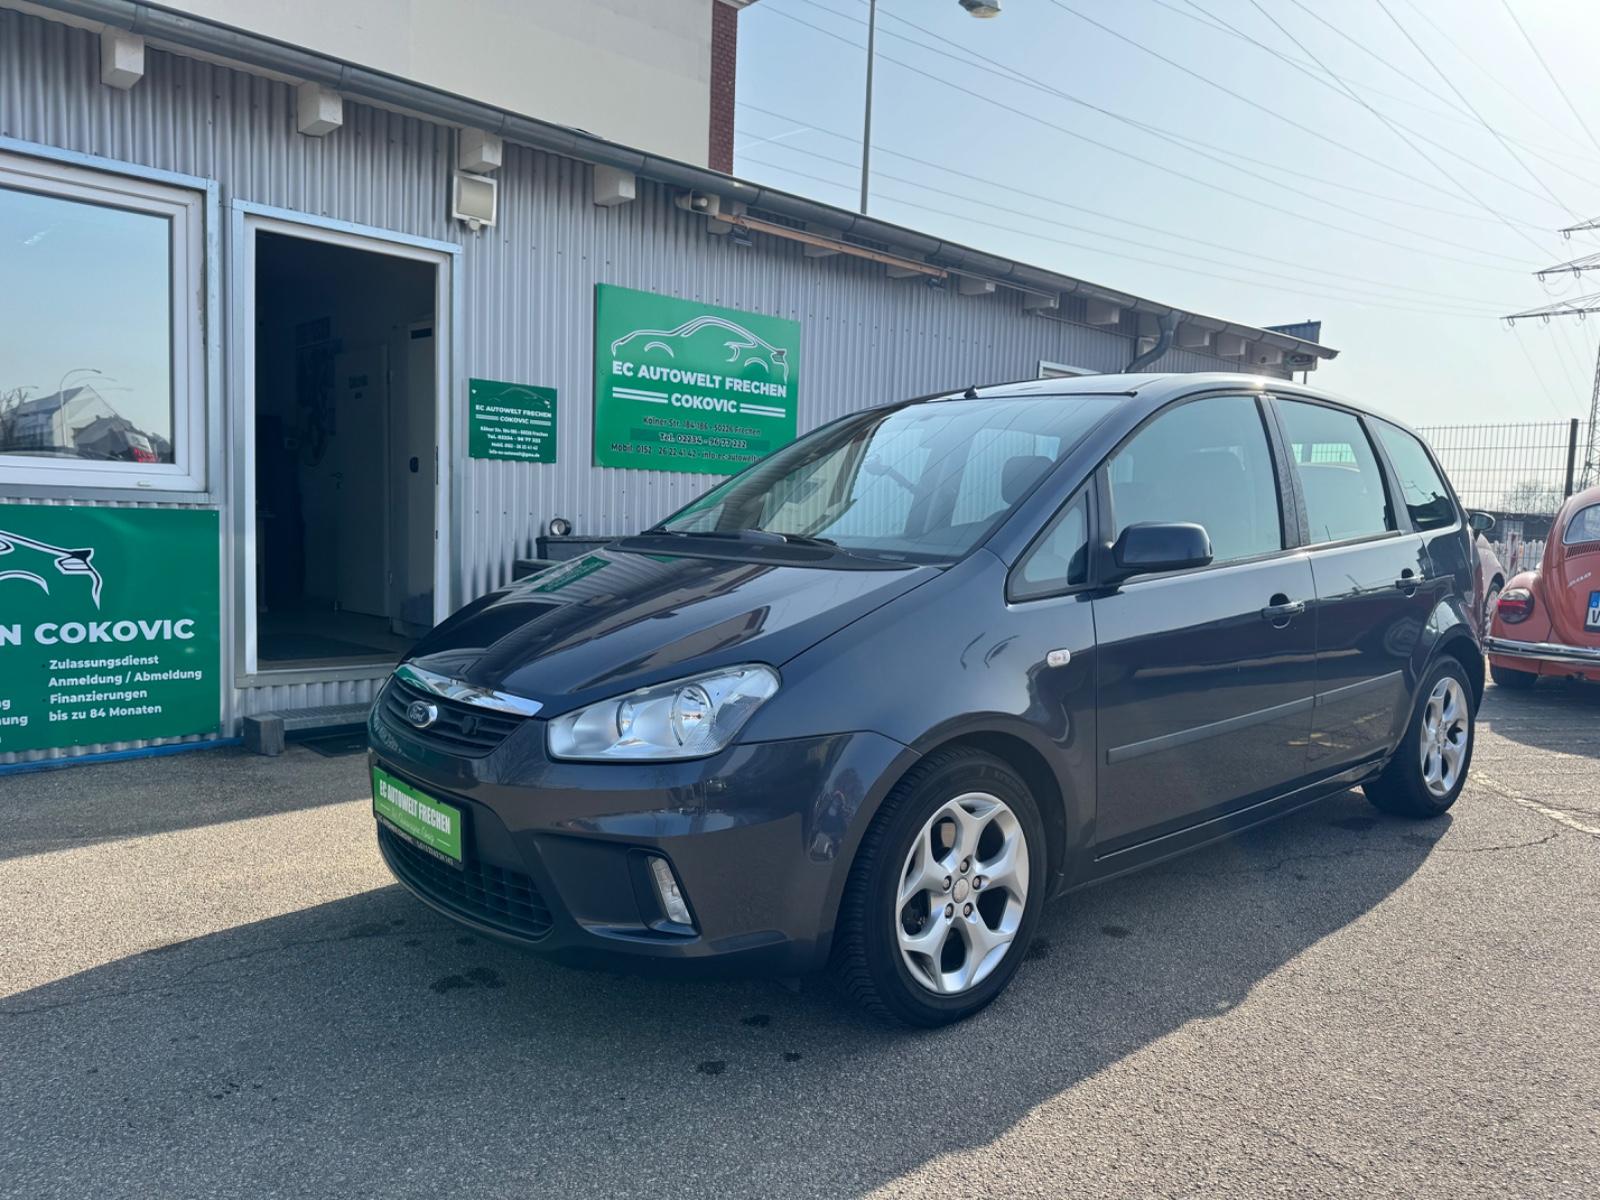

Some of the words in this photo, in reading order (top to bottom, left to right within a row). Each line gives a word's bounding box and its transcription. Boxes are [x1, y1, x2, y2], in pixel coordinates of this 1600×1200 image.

[612, 360, 634, 377] EC
[637, 365, 722, 389] AUTOWELT
[725, 377, 788, 398] FRECHEN
[486, 406, 521, 415] AUTOWELT
[522, 409, 552, 418] FRECHEN
[671, 393, 737, 414] COKOVIC
[500, 415, 530, 424] COKOVIC
[659, 432, 674, 442] Tel.
[735, 426, 761, 437] Frechen
[34, 618, 195, 645] COKOVIC
[49, 654, 159, 670] Zulassungsdienst
[48, 674, 123, 688] Anmeldung
[134, 668, 202, 683] Abmeldung
[50, 689, 148, 705] Finanzierungen
[49, 709, 68, 722] bis
[71, 709, 86, 720] zu
[90, 709, 106, 718] 84
[109, 704, 162, 717] Monaten
[379, 778, 387, 799] EC
[387, 783, 418, 818] AUTOWELT
[418, 801, 451, 835] FRECHEN
